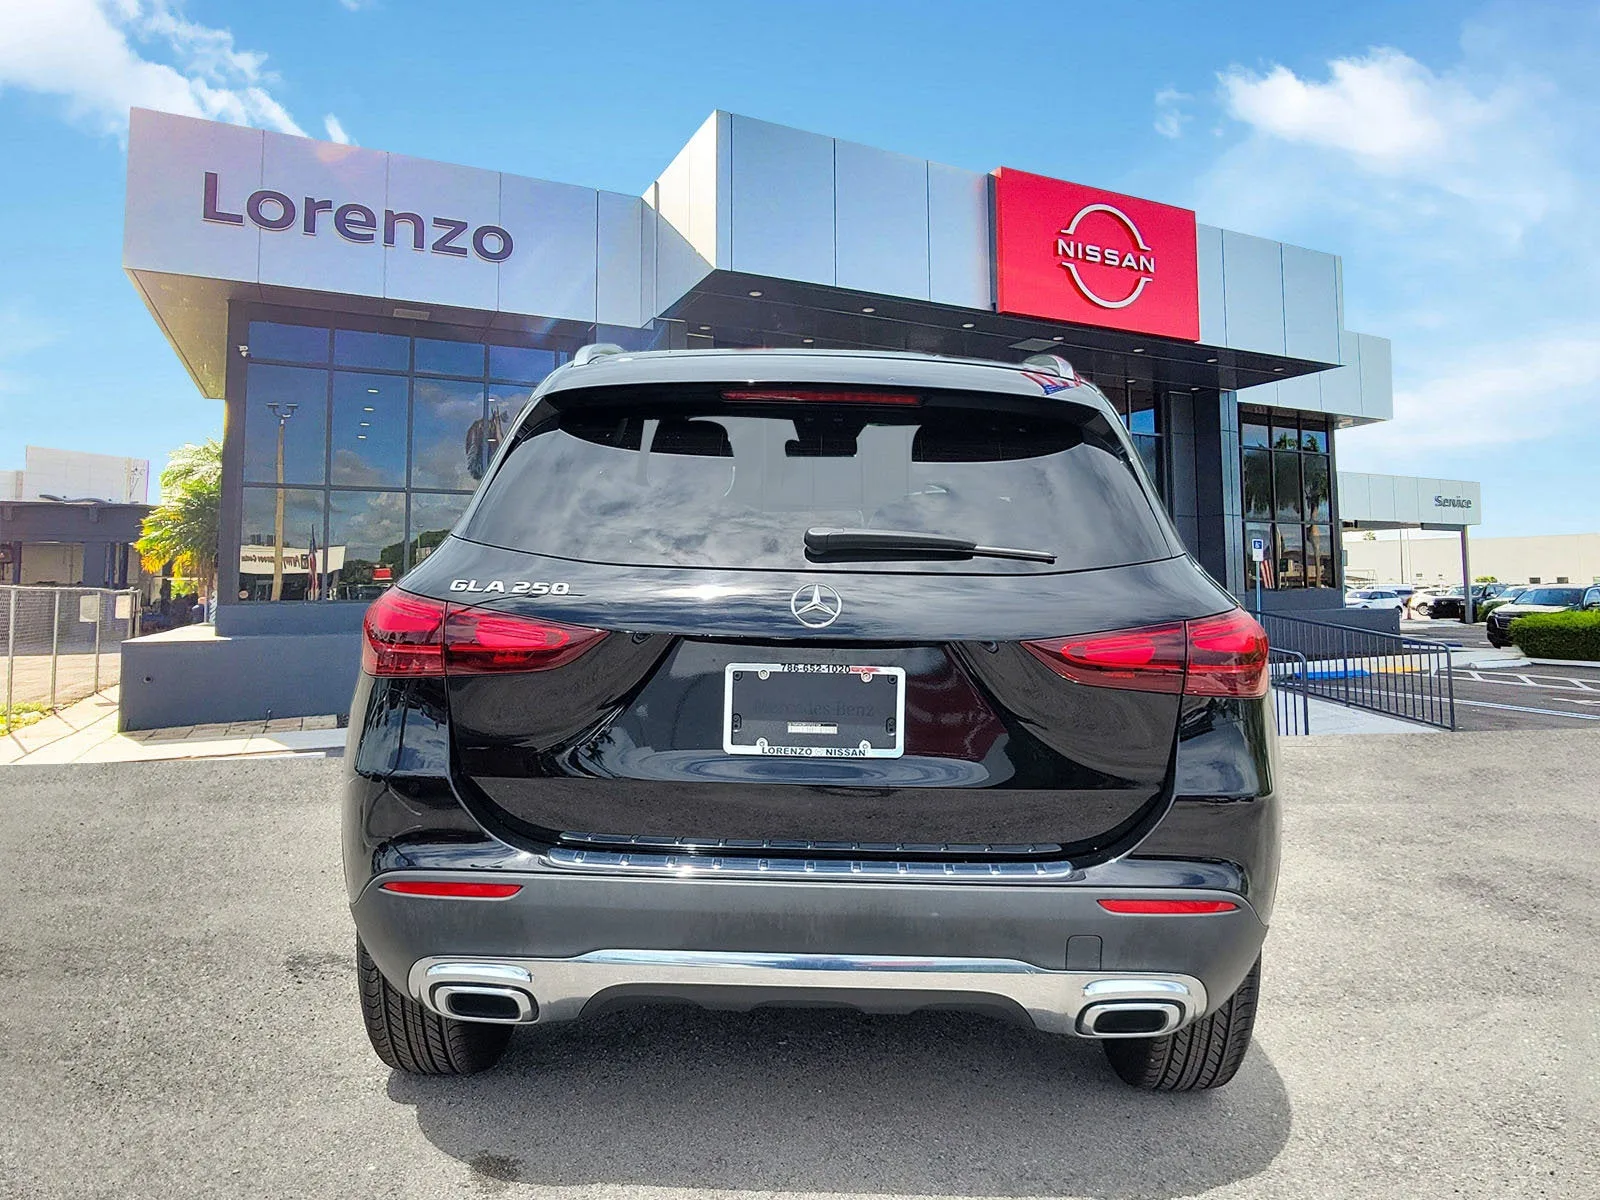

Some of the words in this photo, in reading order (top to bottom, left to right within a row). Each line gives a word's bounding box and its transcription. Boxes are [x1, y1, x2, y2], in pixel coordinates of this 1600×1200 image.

[203, 171, 514, 262] Lorenzo
[1057, 238, 1155, 273] NISSAN
[1434, 495, 1472, 509] Service
[450, 579, 505, 593] GLA
[511, 581, 570, 596] 250
[780, 664, 851, 674] 786-652-1020
[761, 747, 812, 756] LORENZO
[825, 748, 866, 757] NISSAN
